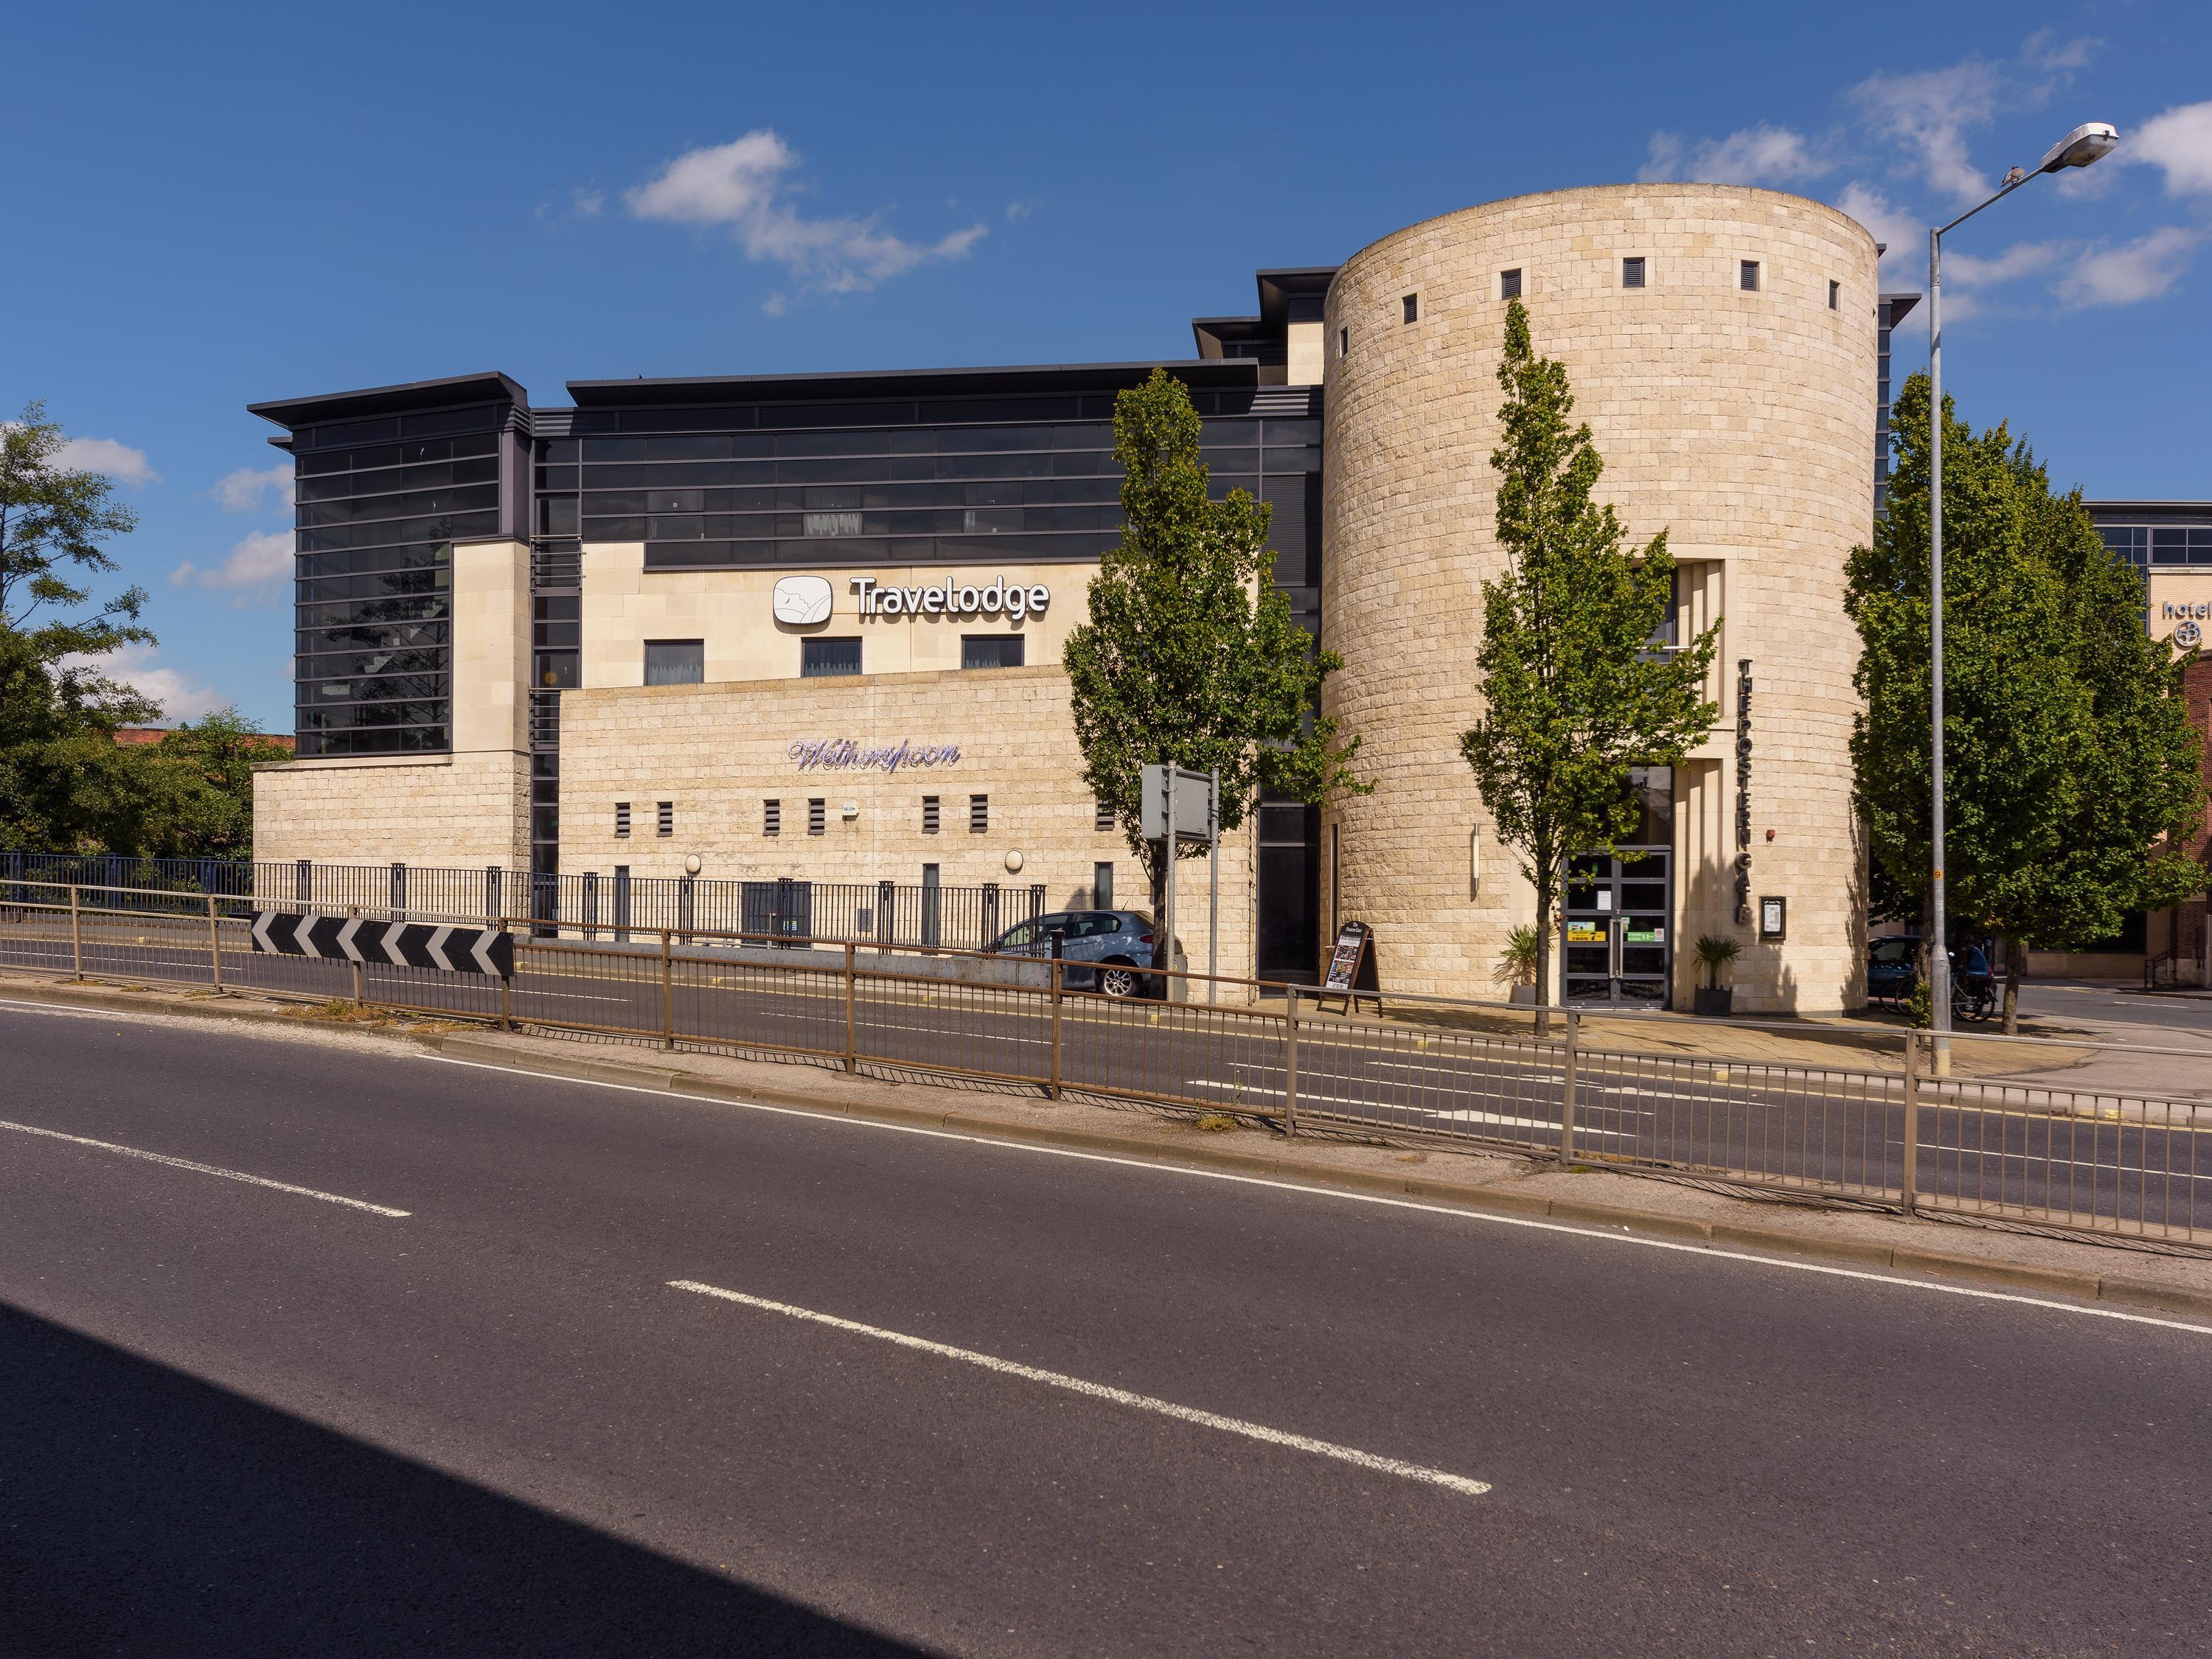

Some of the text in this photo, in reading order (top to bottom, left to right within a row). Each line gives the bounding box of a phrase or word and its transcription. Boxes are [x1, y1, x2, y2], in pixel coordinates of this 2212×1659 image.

[849, 574, 1050, 621] Travelodge
[1738, 659, 1753, 712] THE
[788, 737, 960, 772] Wetherspoon
[1736, 719, 1753, 844] POSTERN
